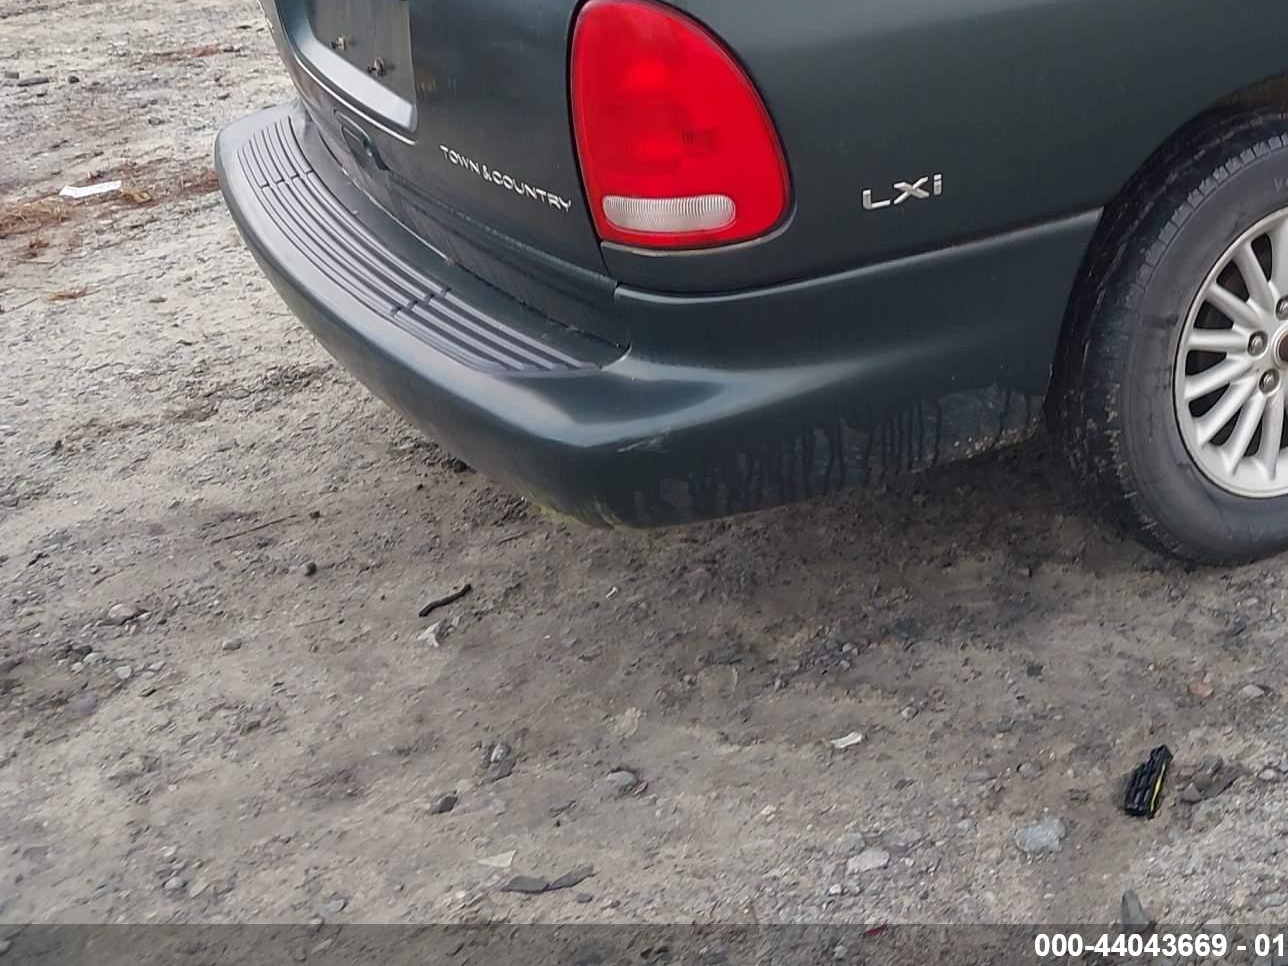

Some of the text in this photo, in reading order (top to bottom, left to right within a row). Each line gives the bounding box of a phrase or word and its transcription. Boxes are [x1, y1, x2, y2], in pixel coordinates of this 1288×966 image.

[439, 144, 481, 175] TOWN
[492, 171, 572, 213] COUNTRY
[862, 173, 943, 211] LXi
